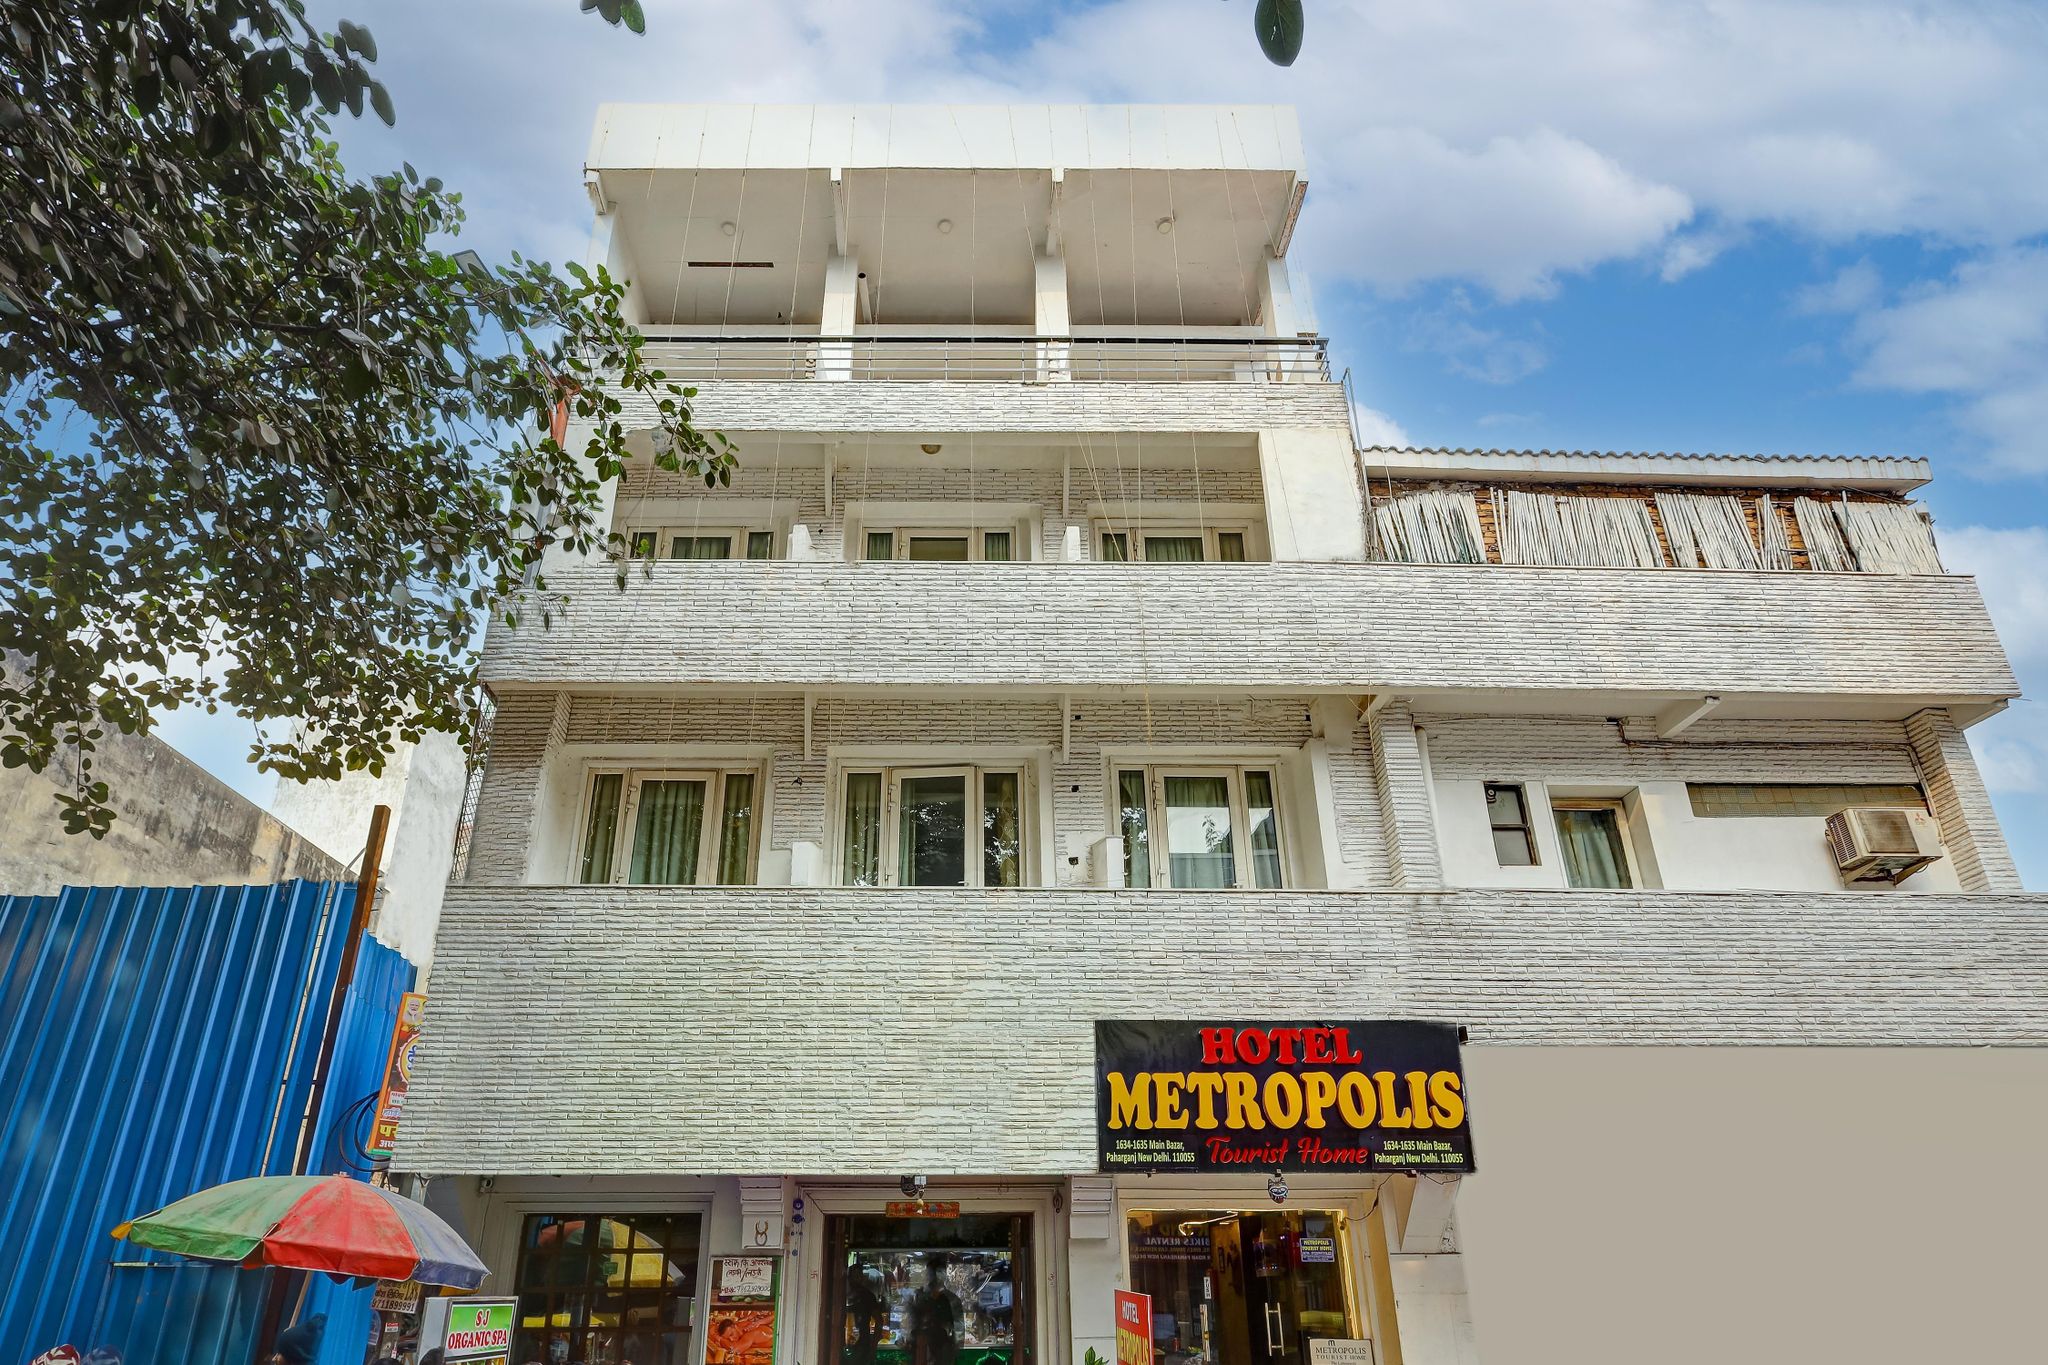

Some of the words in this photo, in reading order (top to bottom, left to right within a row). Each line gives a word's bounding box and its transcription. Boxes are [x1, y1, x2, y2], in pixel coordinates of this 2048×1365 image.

[1199, 1026, 1363, 1065] HOTEL
[1106, 1071, 1466, 1131] METROPOLIS
[1115, 1139, 1148, 1150] 1634-1635
[1149, 1139, 1165, 1150] Main
[1166, 1140, 1185, 1152] Bazar,
[1206, 1136, 1289, 1165] Tourist
[1298, 1136, 1369, 1165] Home
[1383, 1140, 1415, 1151] 1634-1635
[1416, 1140, 1433, 1151] Main
[1434, 1141, 1453, 1152] Bazar,
[1106, 1152, 1137, 1164] Paharganj
[1138, 1152, 1152, 1162] New
[1172, 1152, 1195, 1163] 110055
[1374, 1153, 1406, 1165] Paharganj
[1406, 1153, 1420, 1163] New
[1440, 1153, 1464, 1163] 110055
[1121, 1300, 1140, 1325] HOTEL
[447, 1330, 491, 1350] ORGANIC
[491, 1329, 507, 1346] SPA
[1315, 1346, 1367, 1355] METROPOLIS
